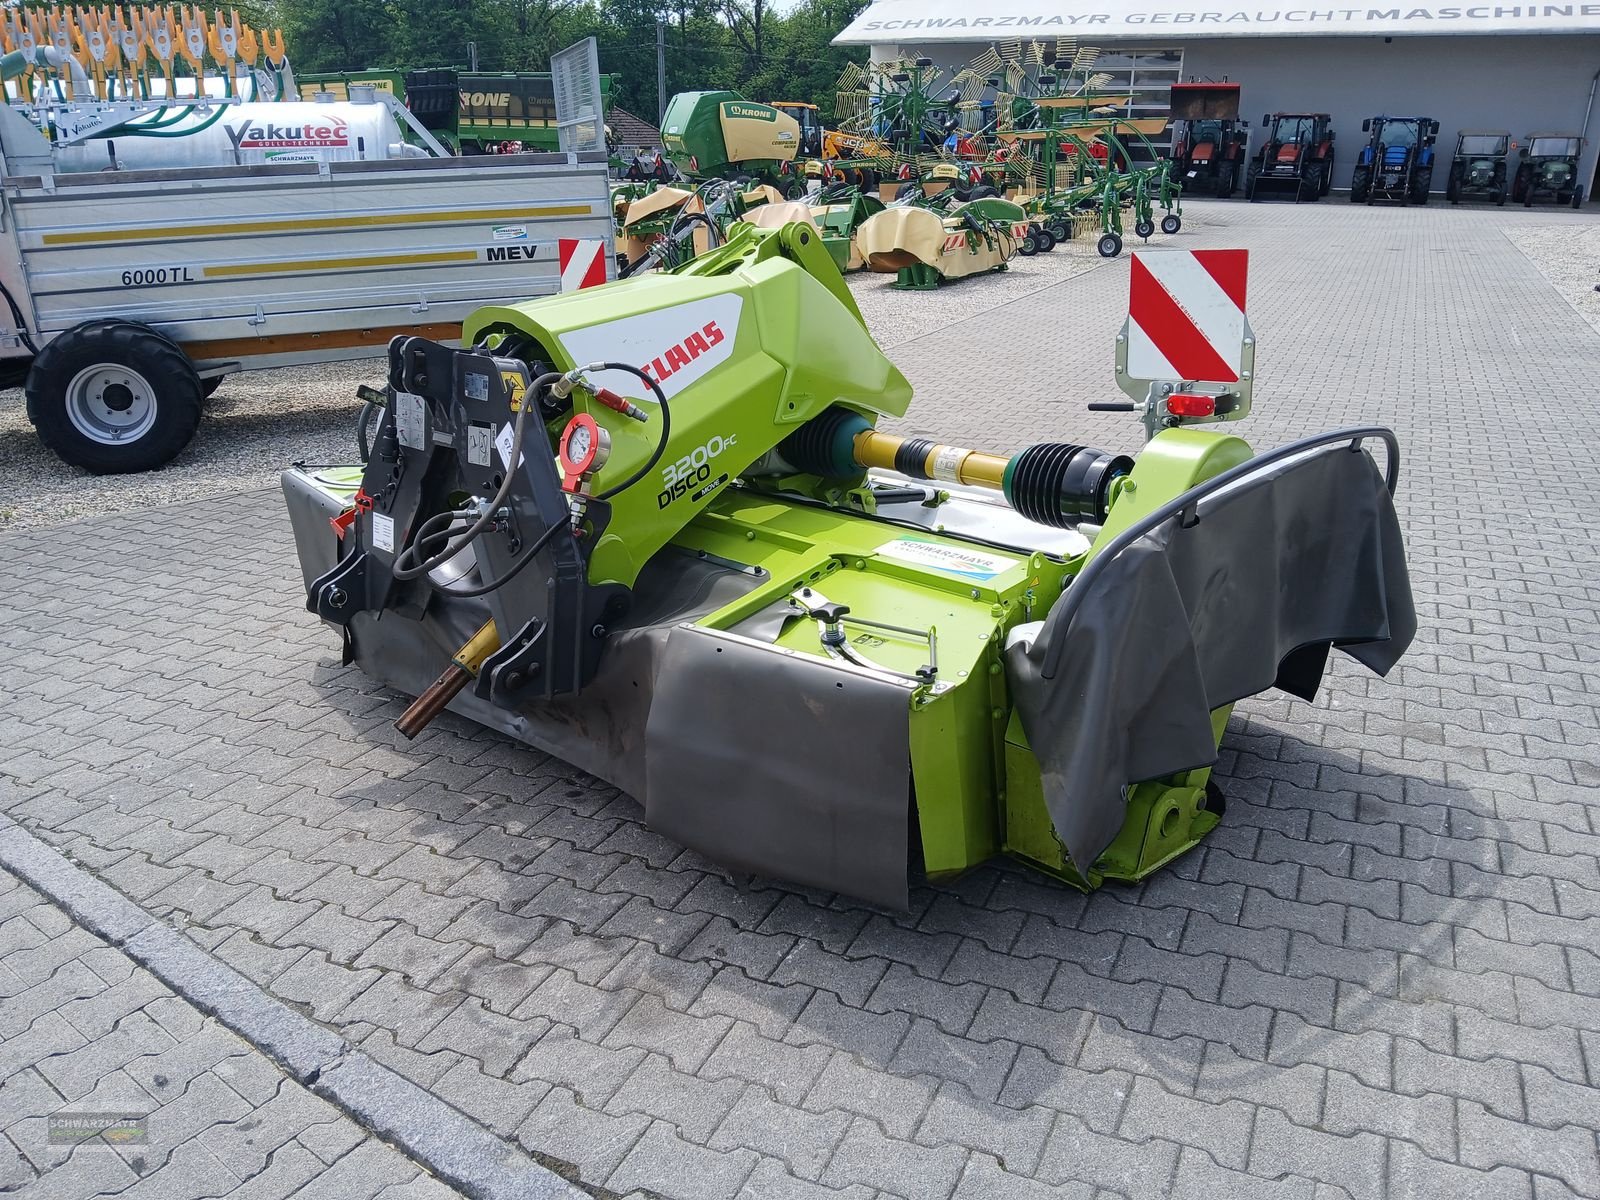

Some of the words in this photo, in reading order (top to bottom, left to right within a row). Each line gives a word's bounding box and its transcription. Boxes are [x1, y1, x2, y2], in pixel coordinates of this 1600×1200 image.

[863, 14, 1111, 31] SCHWARZMAYR
[462, 92, 511, 107] RONE
[741, 109, 771, 119] KRONE
[486, 245, 538, 261] MEV
[639, 320, 725, 391] CLAAS
[657, 463, 711, 510] DISCO
[701, 478, 721, 496] MOVE
[899, 541, 994, 566] SCHWARZMAYR
